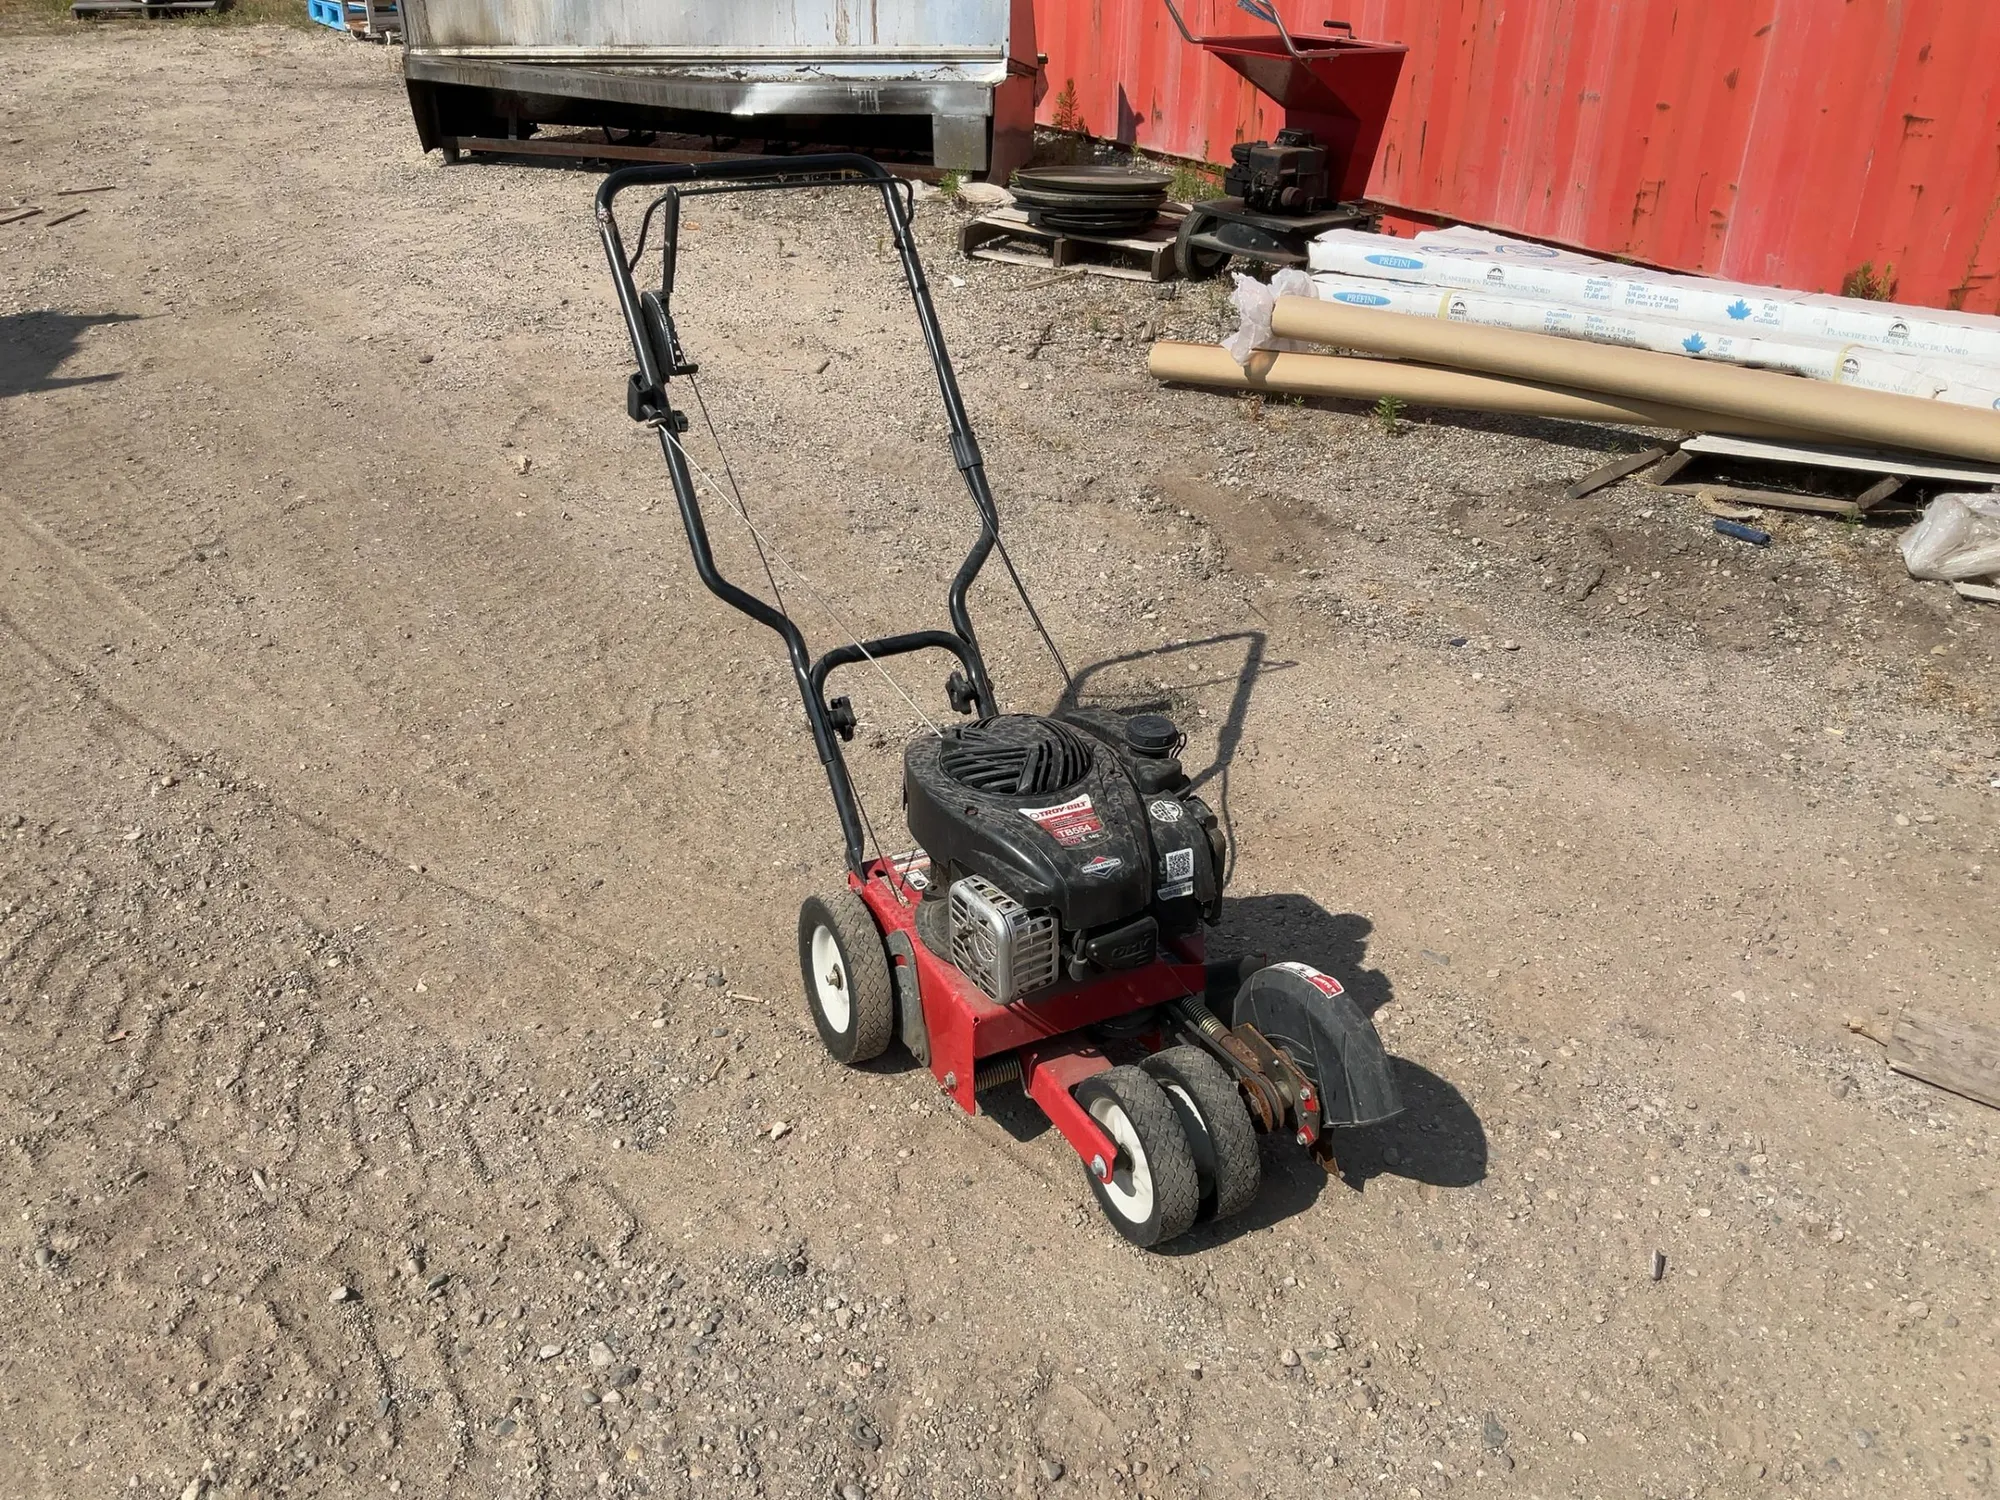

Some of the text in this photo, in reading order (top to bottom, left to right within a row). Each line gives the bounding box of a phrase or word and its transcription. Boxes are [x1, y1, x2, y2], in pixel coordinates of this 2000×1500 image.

[1379, 256, 1411, 268] PRÉFINI
[1531, 285, 1551, 294] NORD
[1346, 293, 1376, 305] PRÉFINI
[1763, 303, 1777, 312] Fait
[1718, 337, 1732, 346] Fait
[1826, 327, 1867, 341] PLANCHER
[1881, 335, 1900, 345] BOIS
[1901, 339, 1929, 350] FRANC
[1930, 344, 1941, 352] DU
[1943, 344, 1969, 356] NORD
[1707, 349, 1736, 360] Canada
[1038, 801, 1087, 817] TROY-BILT
[1057, 824, 1092, 838] TB554
